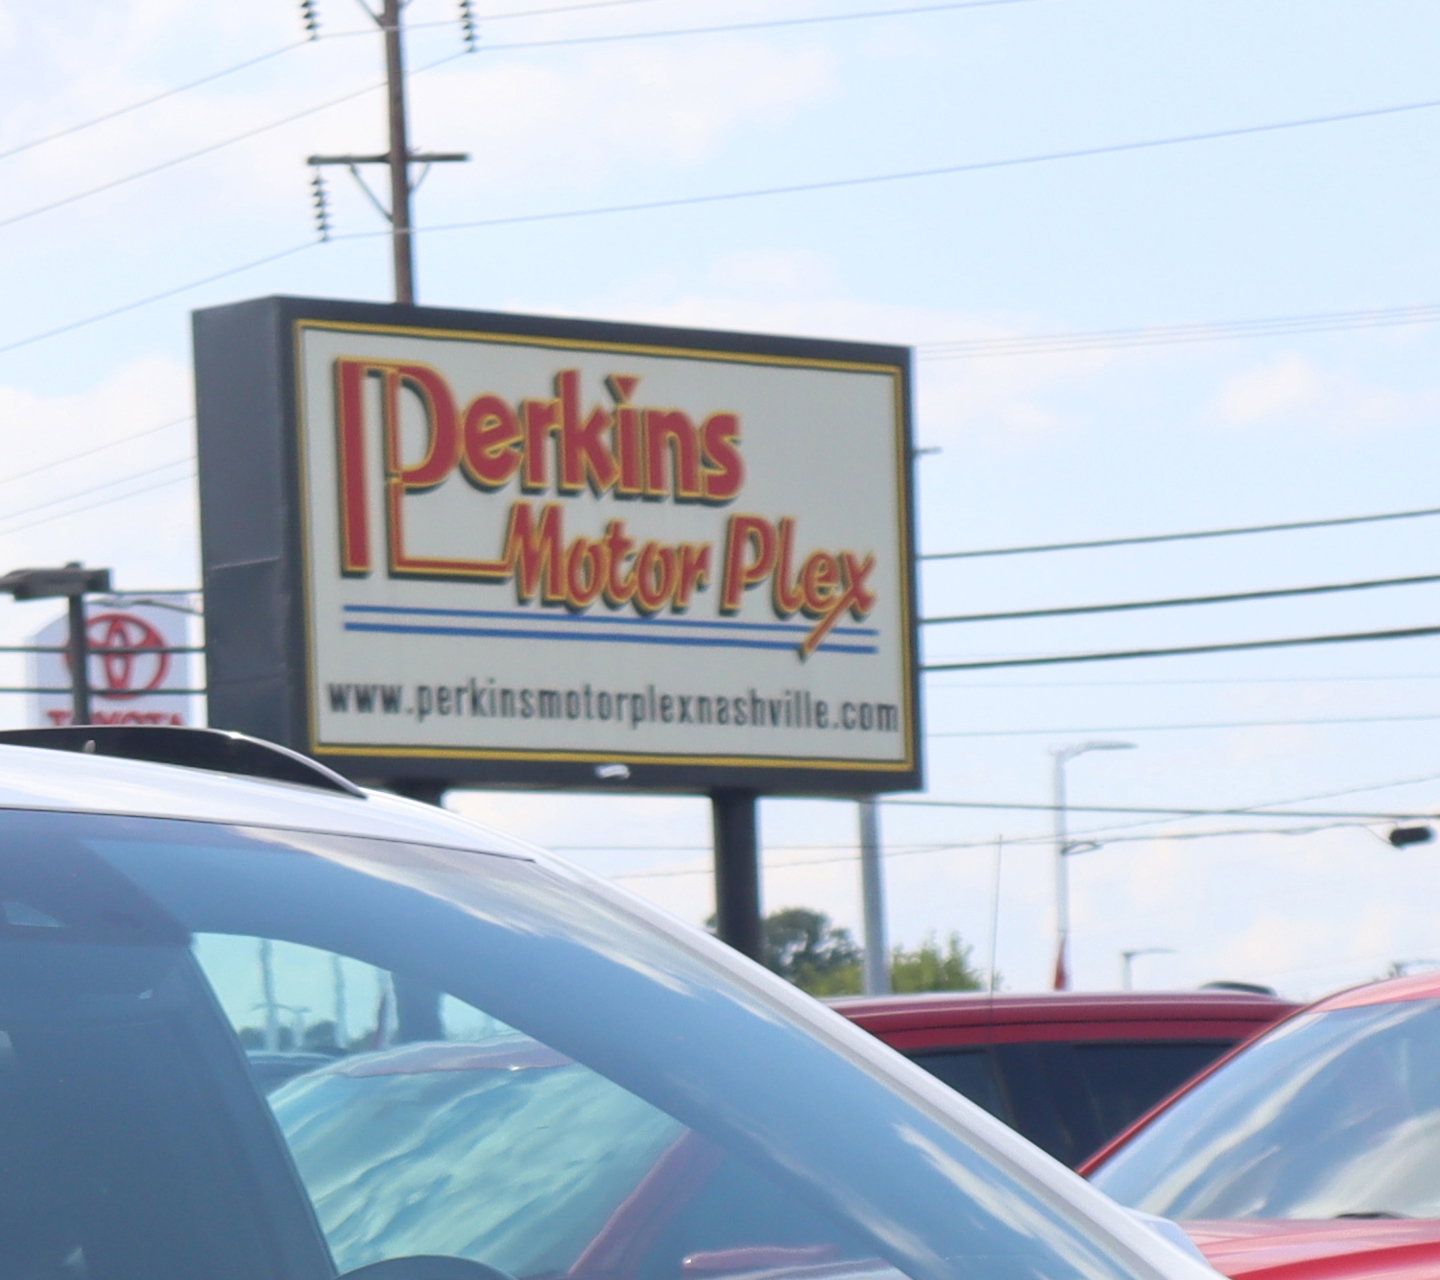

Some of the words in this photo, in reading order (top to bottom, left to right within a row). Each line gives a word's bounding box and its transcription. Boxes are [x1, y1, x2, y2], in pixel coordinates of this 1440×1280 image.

[334, 354, 747, 576] Perkins
[504, 500, 714, 614] Motor
[720, 513, 877, 661] Plex
[47, 710, 188, 727] TYOTA
[326, 677, 900, 733] www.perkinsmotorplexnashville.com
